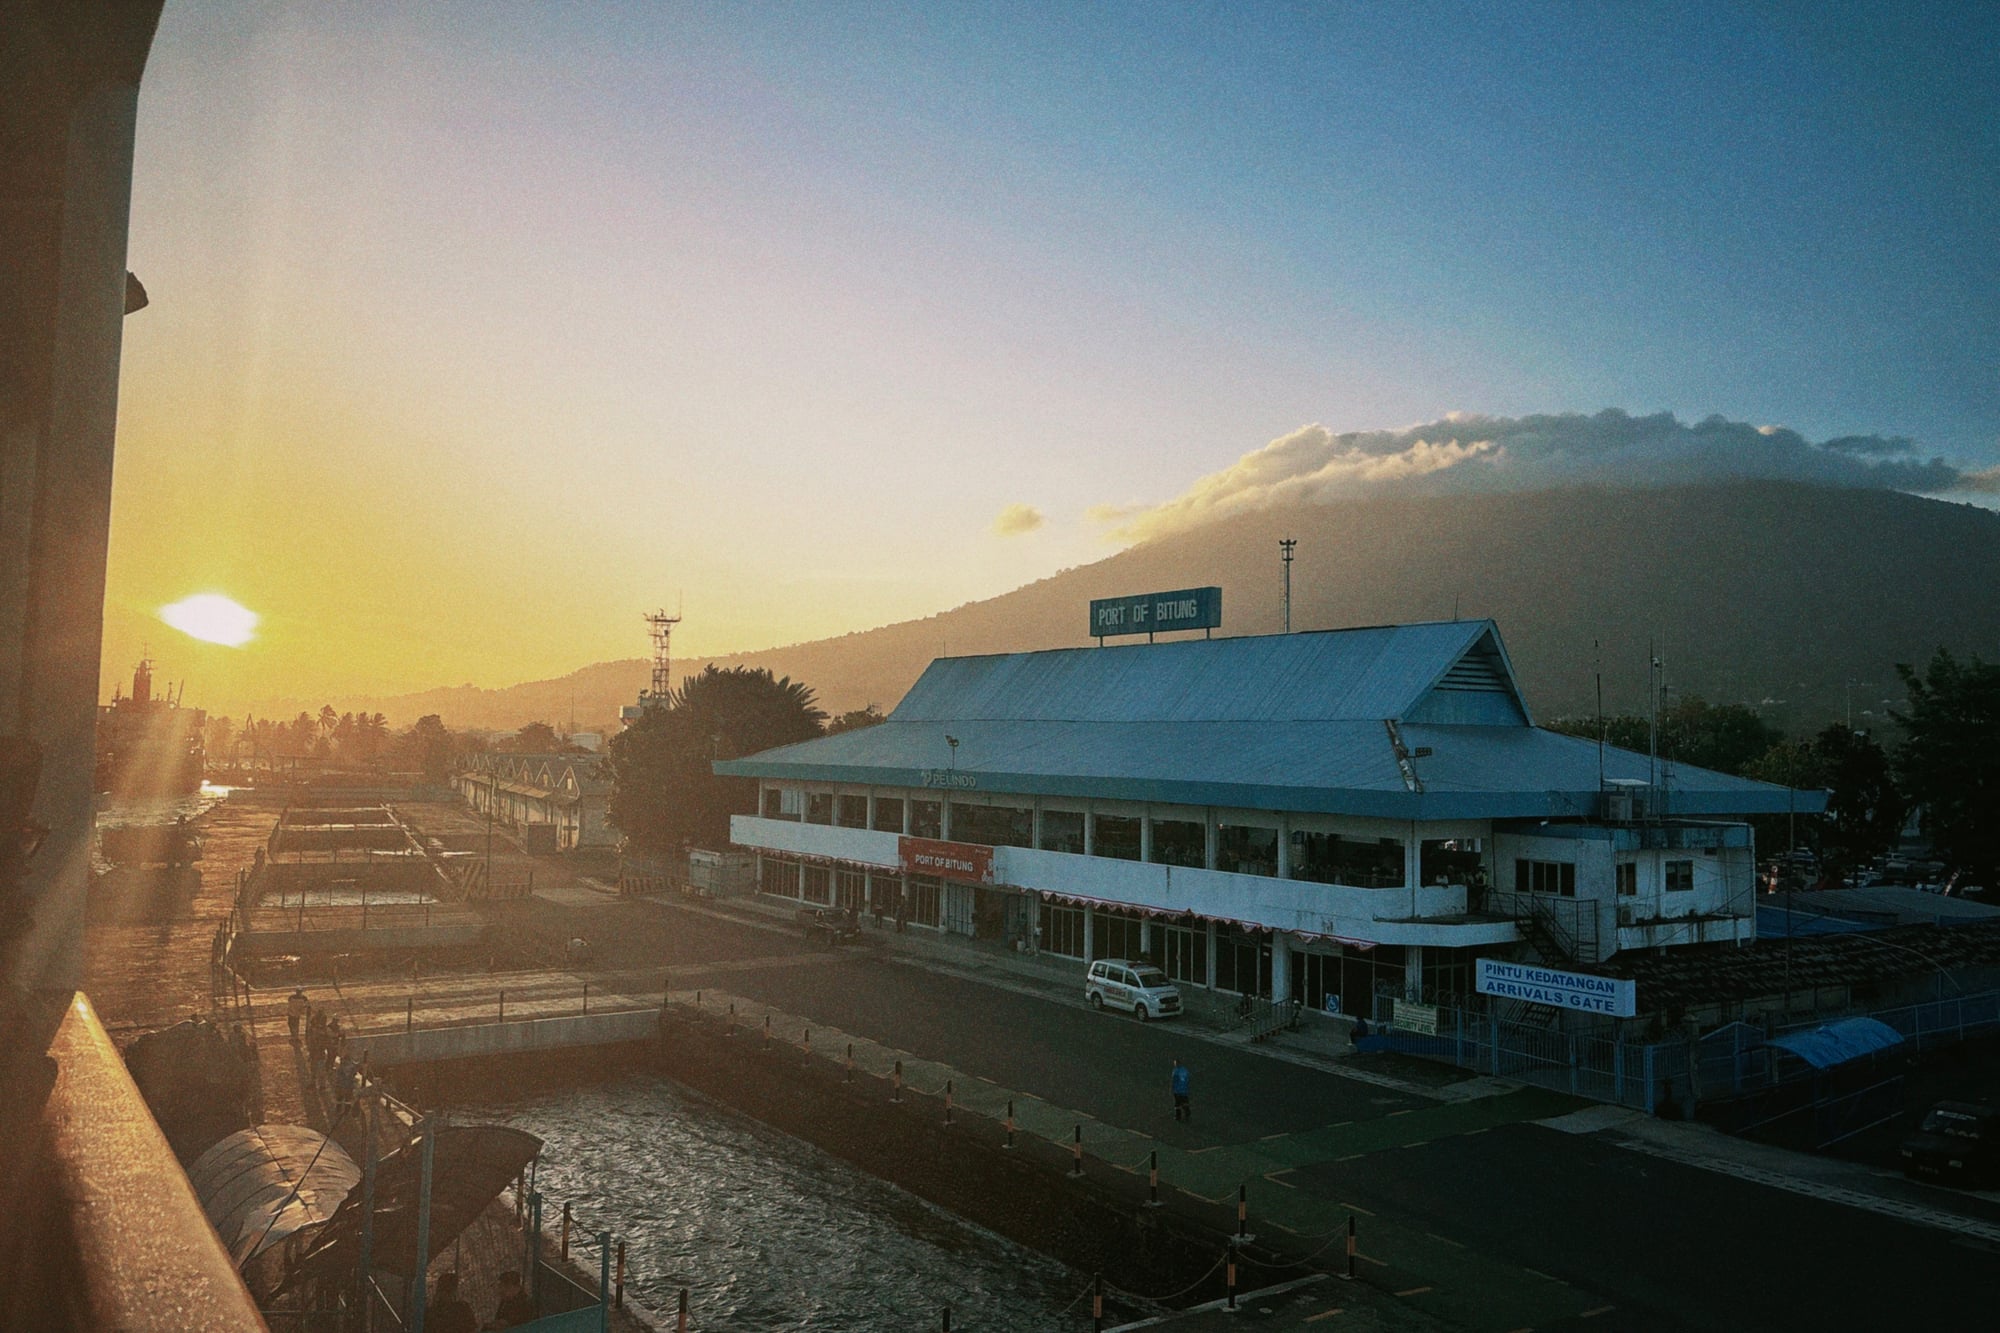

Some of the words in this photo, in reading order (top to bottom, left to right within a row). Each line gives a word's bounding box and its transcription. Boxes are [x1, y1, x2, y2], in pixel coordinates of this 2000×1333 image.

[1099, 607, 1126, 625] PORT
[1133, 604, 1149, 622] OF
[1156, 600, 1197, 620] BITUNG
[933, 773, 976, 787] PELINDO
[915, 854, 932, 866] PORT
[935, 857, 945, 867] OF
[945, 859, 973, 872] BITUNG
[1485, 963, 1522, 978] PINTU
[1526, 970, 1615, 993] KEDATANGAN
[1486, 981, 1563, 1003] ARRIVALS
[1570, 994, 1615, 1012] GATE
